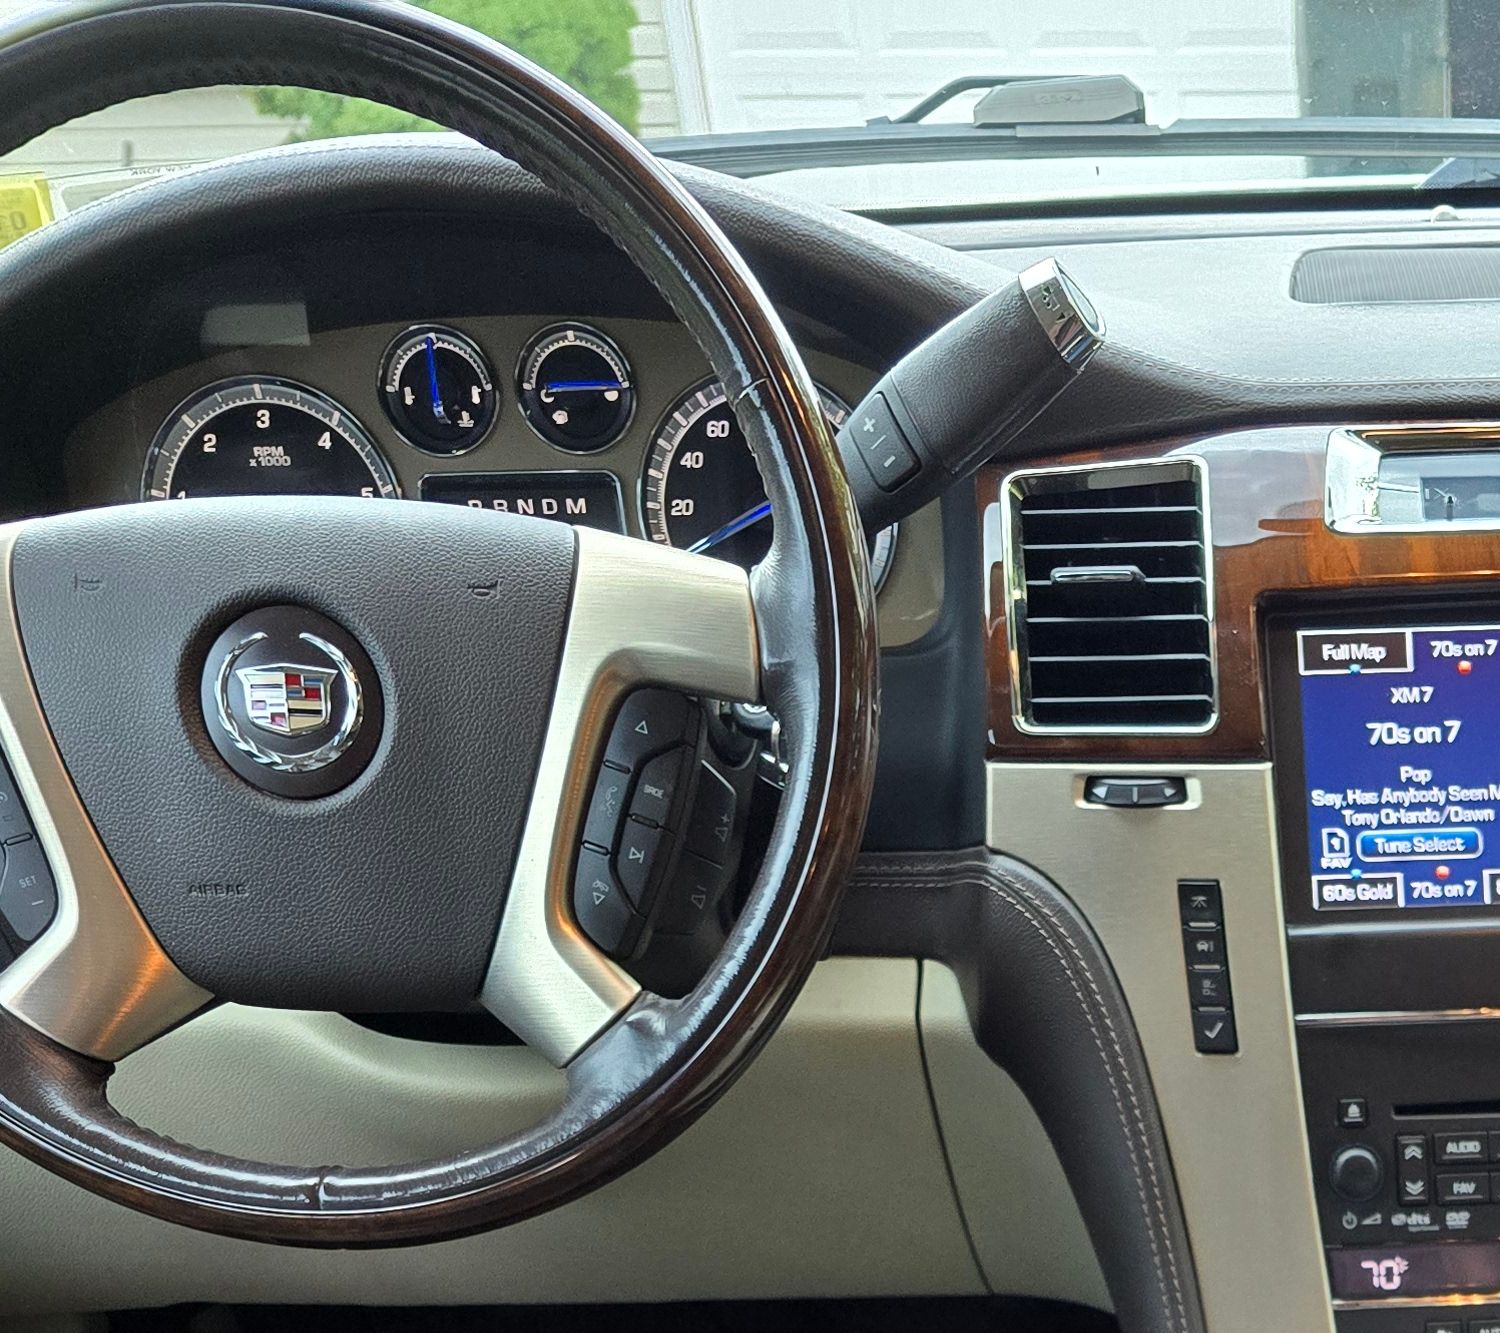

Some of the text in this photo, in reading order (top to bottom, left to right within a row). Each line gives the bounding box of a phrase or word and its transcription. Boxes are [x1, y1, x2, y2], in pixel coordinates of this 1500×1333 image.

[256, 409, 271, 429] 3
[706, 420, 730, 438] 60
[203, 433, 217, 453] 2
[318, 432, 332, 450] 4
[253, 446, 285, 458] RPM
[680, 451, 704, 469] 40
[671, 499, 694, 516] 20
[1321, 643, 1387, 663] Full Map
[1430, 639, 1499, 657] 70s on 7
[1390, 685, 1434, 705] XM 7
[1365, 720, 1462, 746] 70s on 7
[1400, 765, 1433, 785] Pop
[1347, 789, 1379, 806] Has
[1381, 786, 1447, 807] Anybody
[1448, 785, 1490, 802] Seen
[1341, 809, 1379, 829] Tony
[1375, 836, 1467, 855] Tune Select
[18, 875, 38, 889] SET
[1410, 880, 1478, 899] 70s on 7
[1322, 884, 1394, 902] 60s Gold
[1453, 1181, 1476, 1195] FAV
